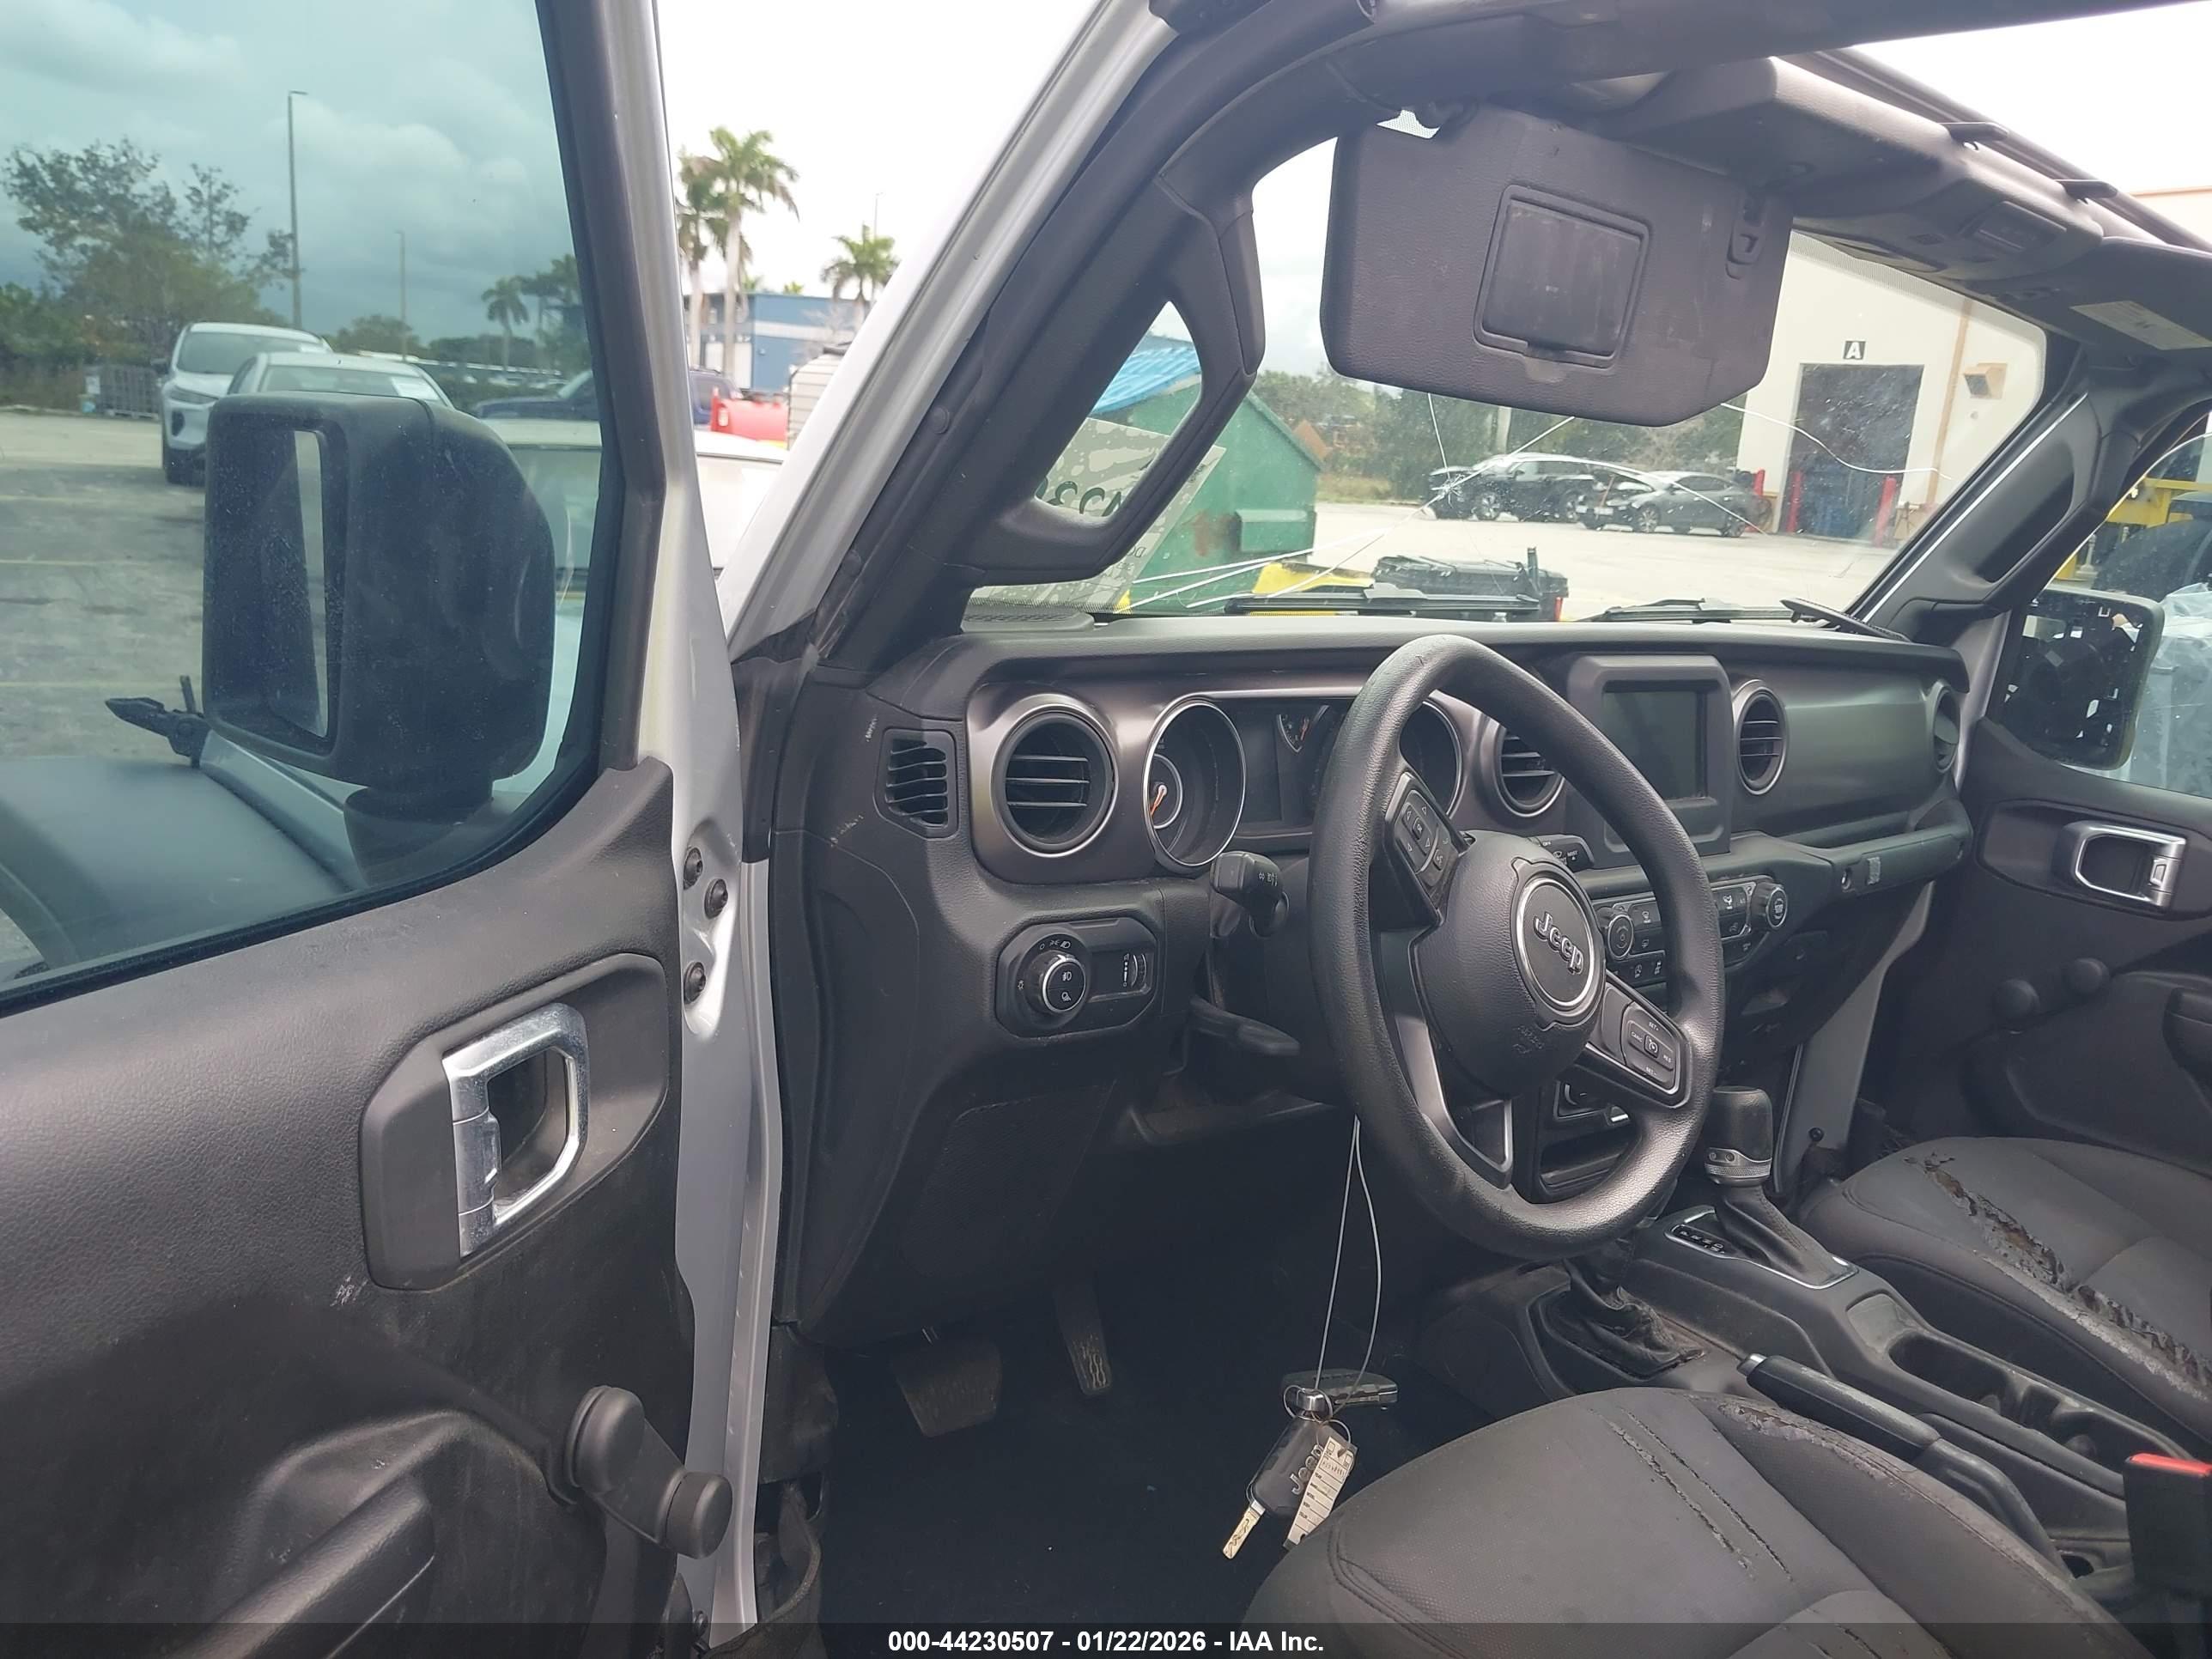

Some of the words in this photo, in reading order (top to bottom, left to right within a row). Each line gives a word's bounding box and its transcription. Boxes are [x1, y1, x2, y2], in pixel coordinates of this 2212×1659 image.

[1845, 342, 1863, 359] A
[1533, 911, 1584, 975] Jeep
[1289, 1444, 1323, 1495] Jeep
